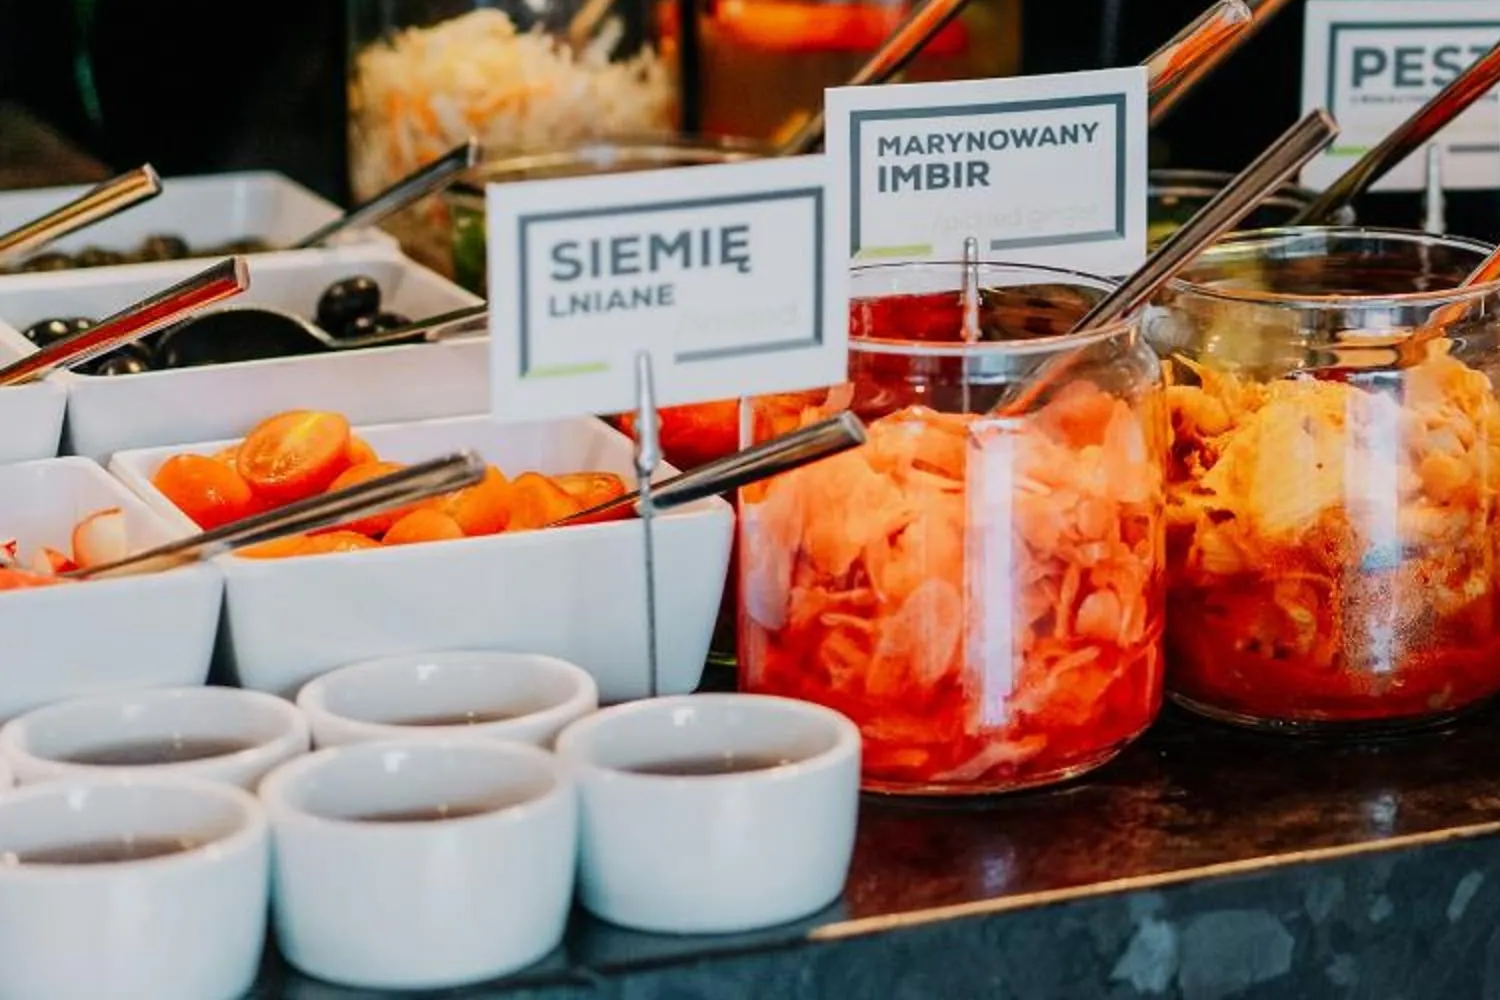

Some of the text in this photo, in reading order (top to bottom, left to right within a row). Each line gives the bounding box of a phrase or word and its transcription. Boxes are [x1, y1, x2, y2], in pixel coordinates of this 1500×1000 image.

[877, 121, 1100, 157] MARYNOWANY
[877, 160, 992, 194] IMBIR
[550, 224, 752, 283] SIEMIĘ
[549, 284, 676, 319] LNIANE
